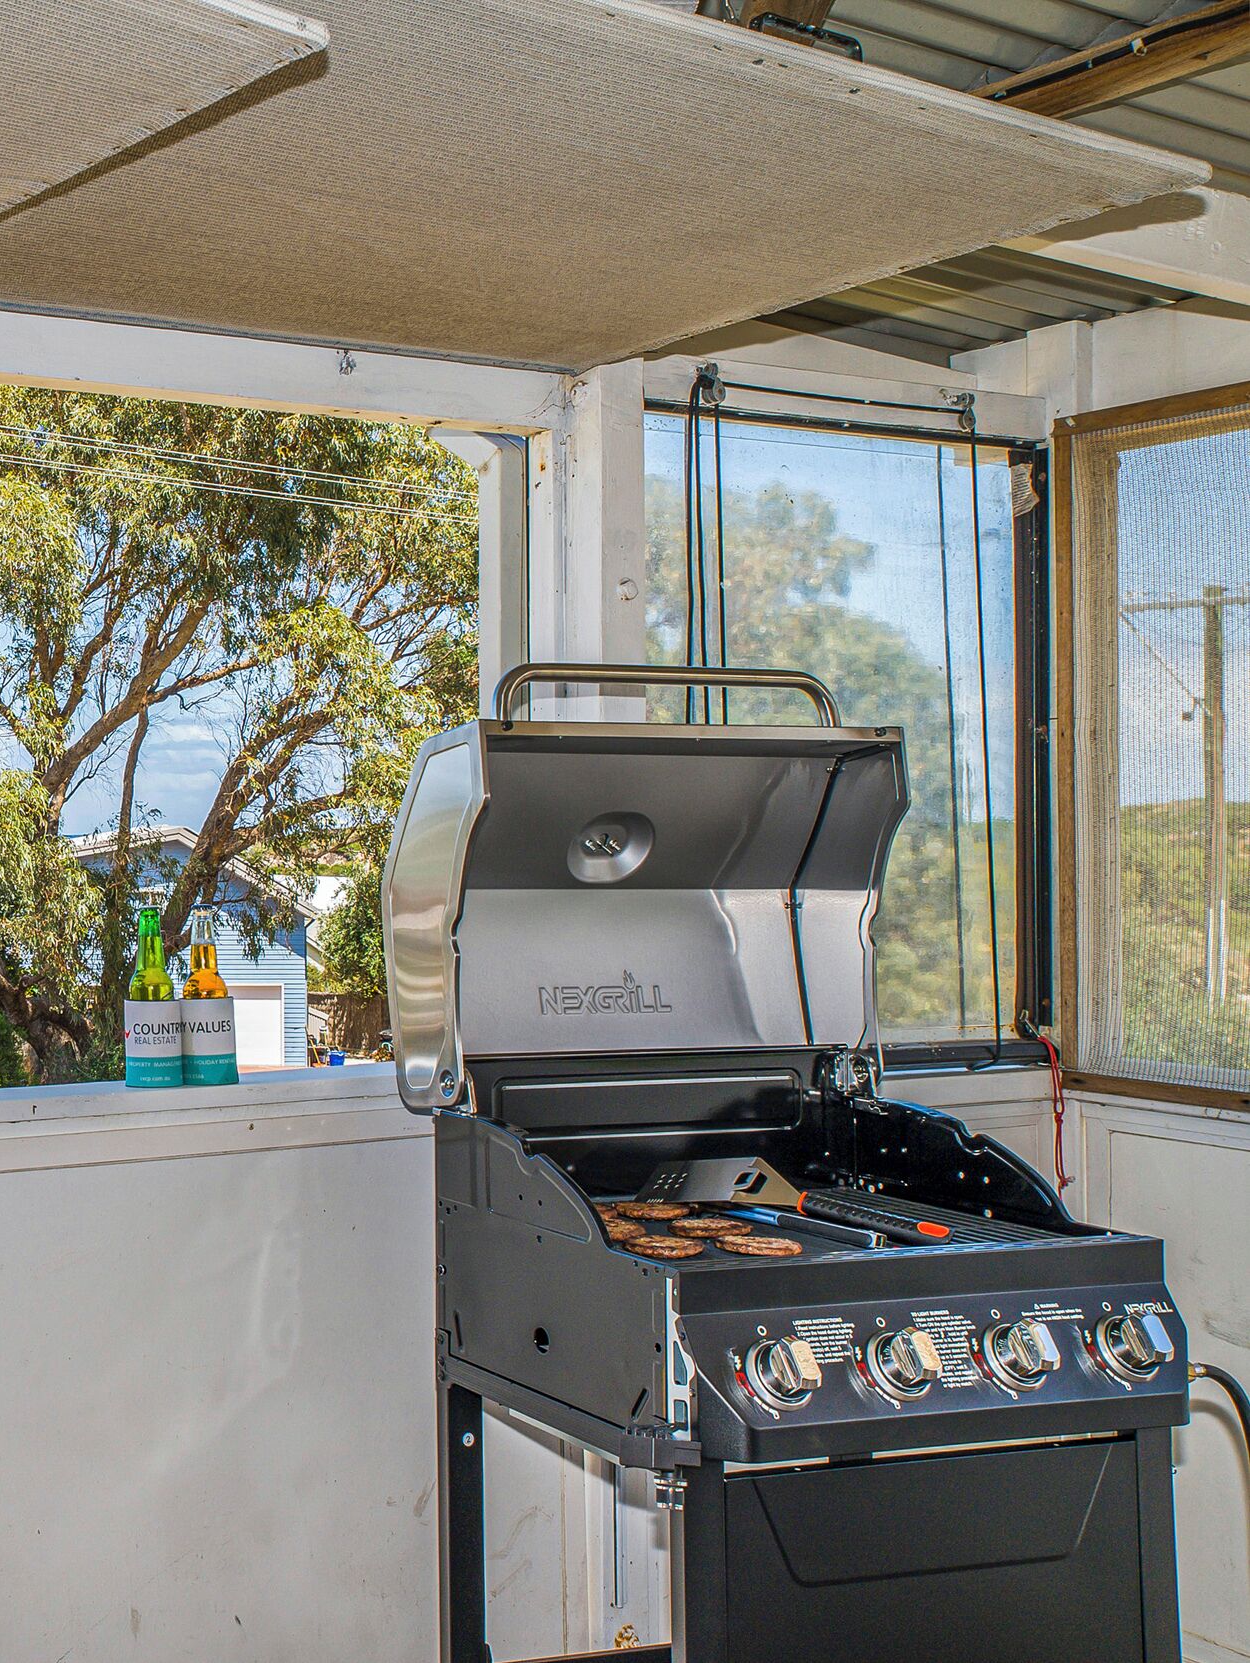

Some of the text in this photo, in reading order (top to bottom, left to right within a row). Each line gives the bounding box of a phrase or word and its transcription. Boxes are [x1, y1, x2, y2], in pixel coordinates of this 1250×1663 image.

[538, 982, 673, 1016] NEXGRILL
[188, 1020, 232, 1034] VALUES
[134, 1035, 177, 1045] REAL ESTATE
